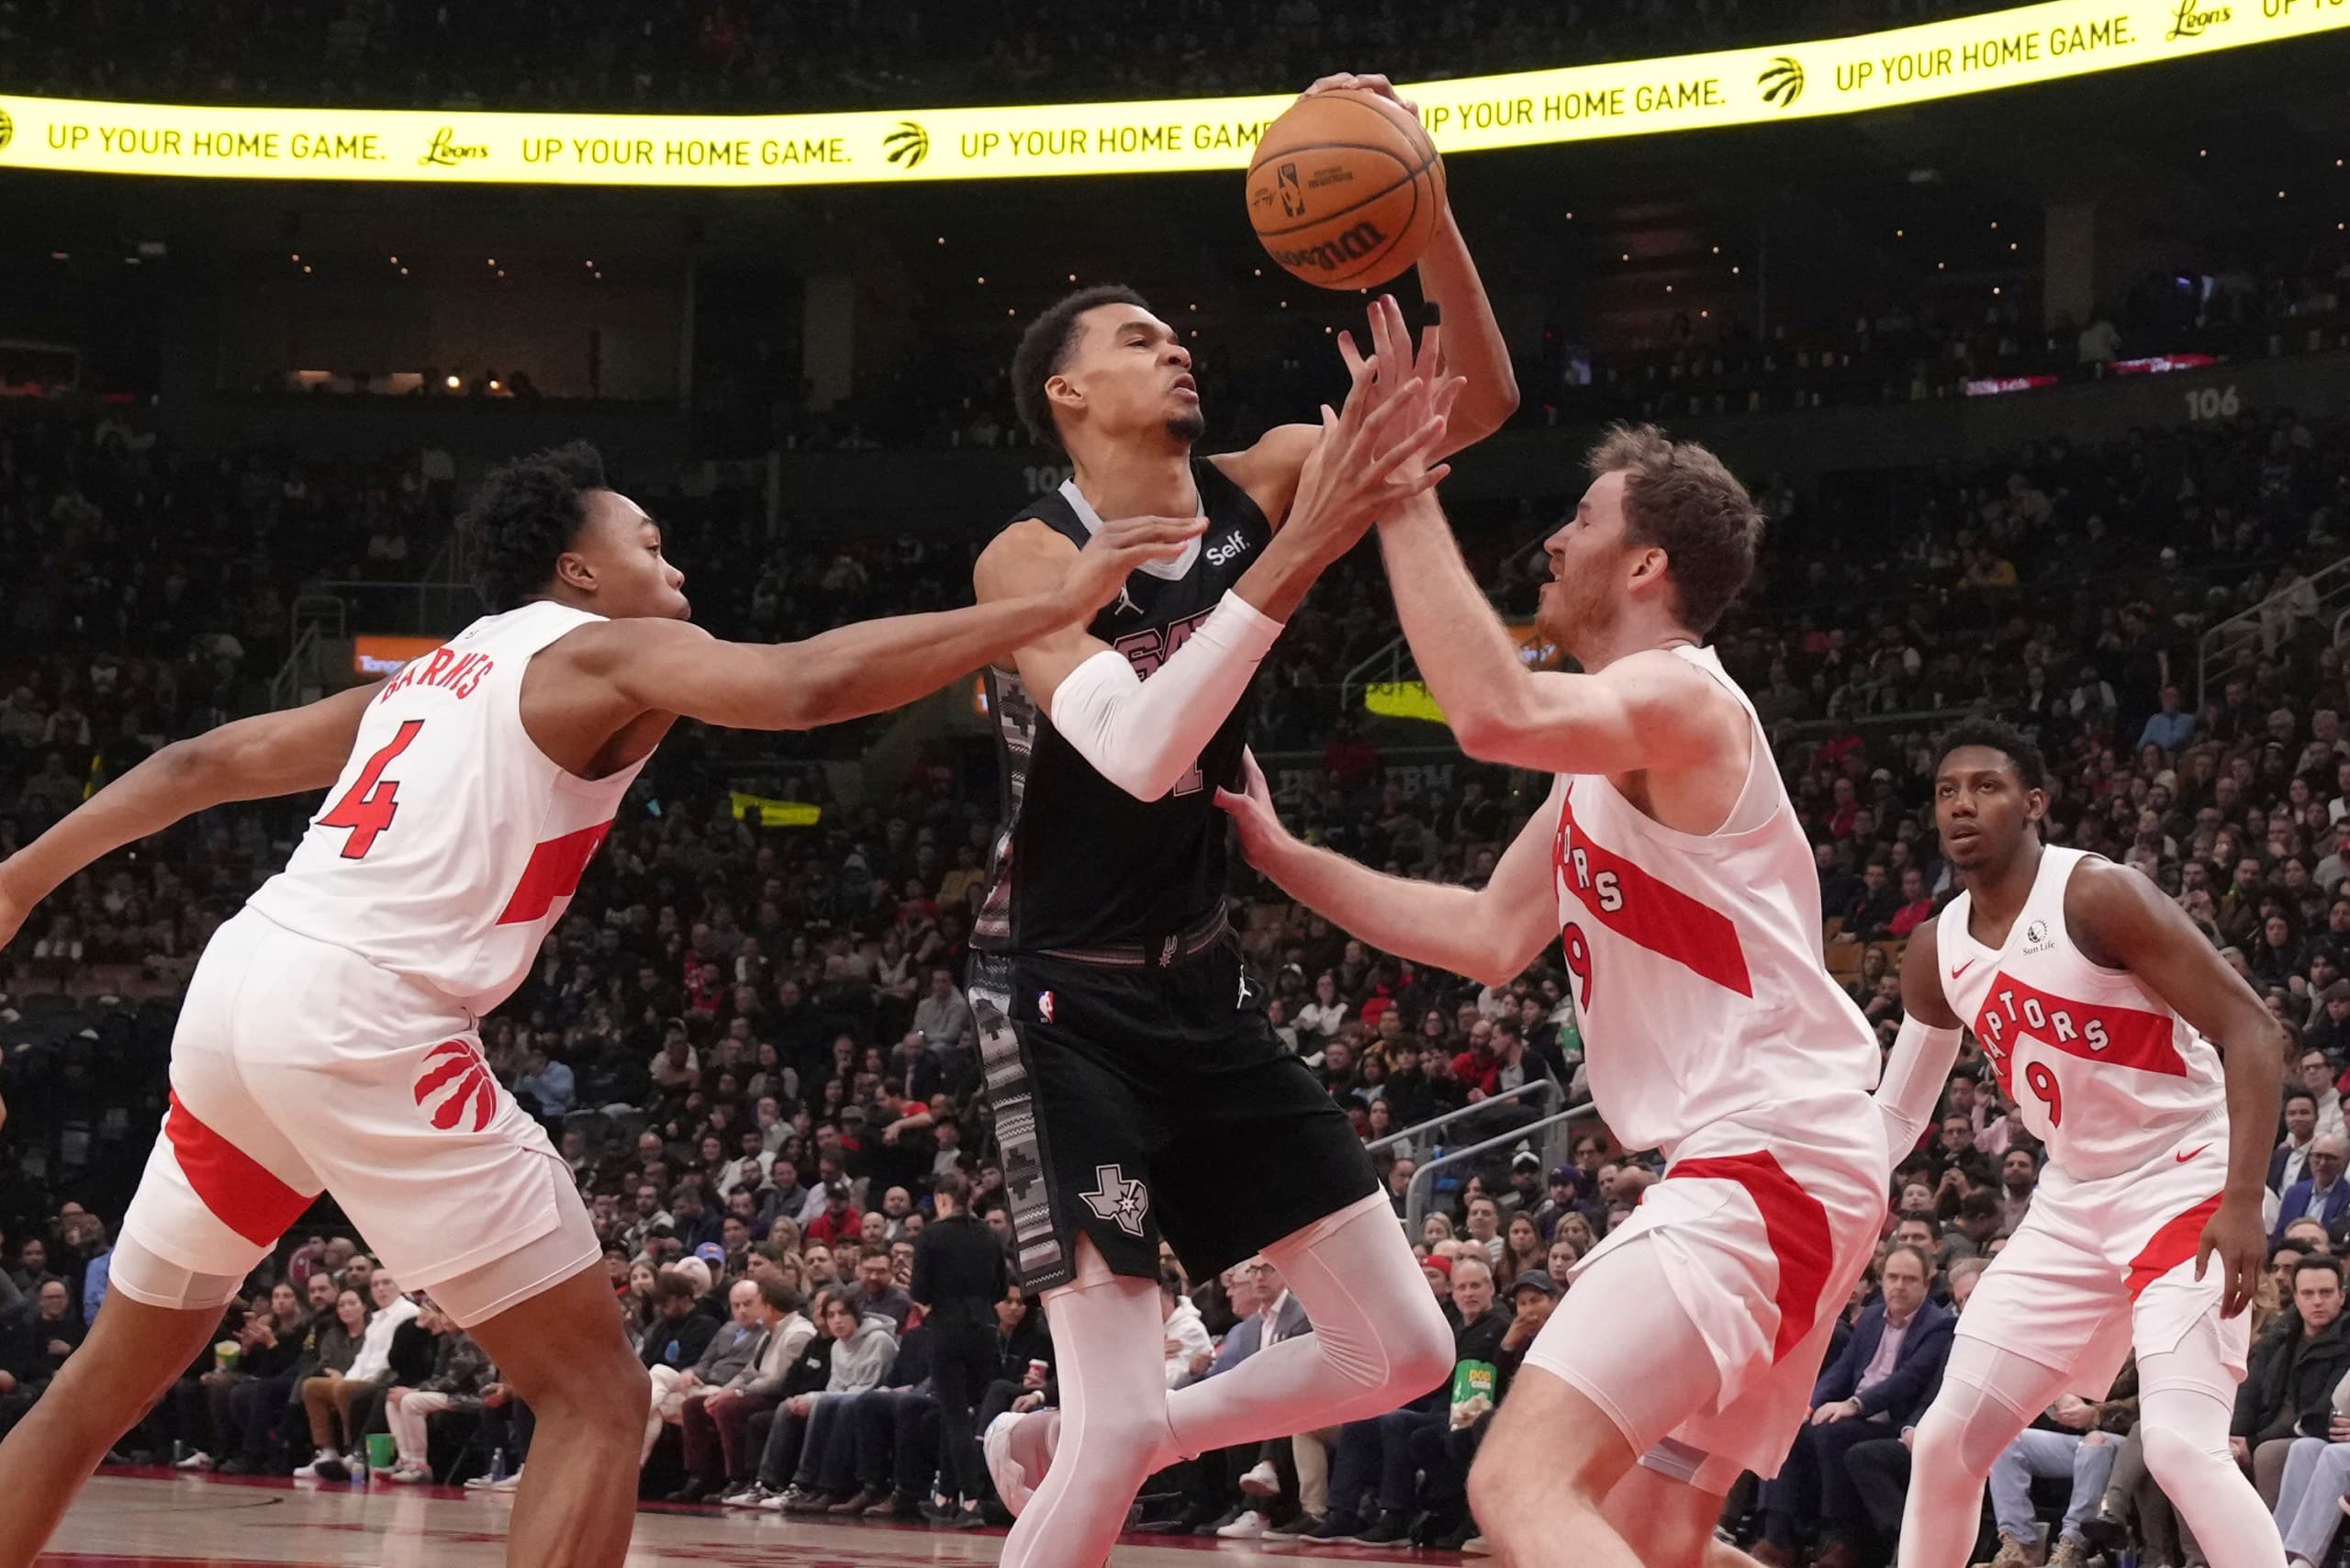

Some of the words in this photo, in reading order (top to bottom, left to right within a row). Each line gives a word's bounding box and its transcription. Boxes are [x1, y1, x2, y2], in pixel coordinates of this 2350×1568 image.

[1836, 61, 1874, 92] UP
[1881, 48, 1953, 84] YOUR
[1962, 31, 2040, 72] HOME
[2050, 15, 2136, 56] GAME.
[1458, 97, 1534, 130] YOUR
[1544, 88, 1625, 122] HOME
[1636, 78, 1726, 113] GAME.
[48, 123, 90, 151] UP
[99, 126, 181, 155] YOUR
[193, 130, 279, 160] HOME
[290, 133, 387, 161] GAME.
[522, 138, 565, 163] UP
[573, 139, 654, 165] YOUR
[665, 140, 750, 166] HOME
[761, 138, 852, 166] GAME.
[960, 131, 1000, 158] UP
[1009, 128, 1088, 156] YOUR
[1098, 125, 1182, 152] HOME
[2186, 386, 2239, 420] 106
[316, 719, 425, 859] 4
[1562, 922, 1593, 1015] 9
[2022, 946, 2039, 957] Sun
[2040, 940, 2056, 952] Life
[1982, 990, 2110, 1078] RAPTORS
[2025, 1060, 2062, 1129] 9
